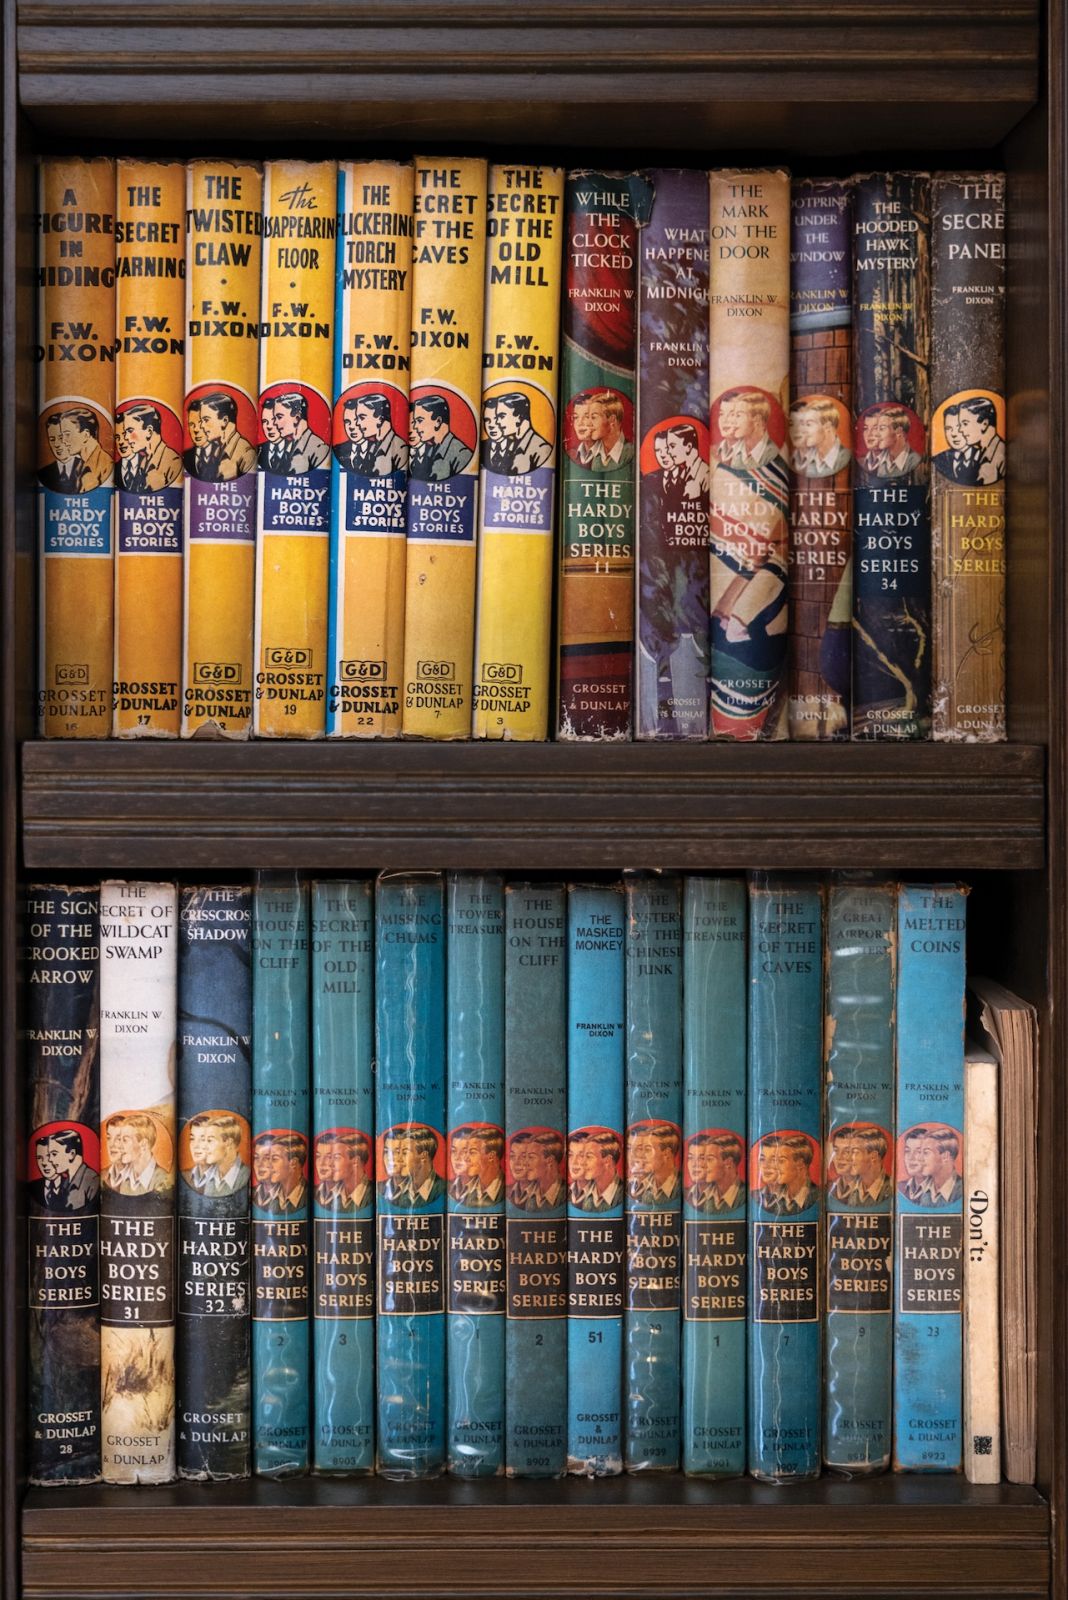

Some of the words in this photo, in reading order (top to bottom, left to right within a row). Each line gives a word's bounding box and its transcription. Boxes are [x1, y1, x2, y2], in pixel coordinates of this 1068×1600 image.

[418, 170, 461, 188] THE
[503, 170, 543, 188] THE
[204, 175, 241, 200] THE
[728, 184, 763, 198] THE
[62, 189, 78, 206] A
[127, 187, 161, 207] THE
[363, 185, 390, 205] THE
[576, 192, 630, 207] WHILE
[722, 205, 769, 218] MARK
[872, 202, 901, 214] THE
[185, 209, 262, 236] TWISTED
[586, 213, 620, 228] THE
[795, 214, 838, 226] UNDER
[516, 218, 553, 239] THE
[711, 225, 737, 239] ON
[742, 225, 777, 239] THE
[855, 220, 919, 234] HOODED
[572, 233, 631, 249] CLOCK
[866, 239, 909, 251] HAWK
[60, 240, 83, 257] IN
[195, 242, 251, 267] CLAW
[346, 242, 396, 263] TORCH
[499, 242, 541, 261] OLD
[719, 246, 769, 259] DOOR
[278, 248, 319, 269] FLOOR
[571, 253, 633, 269] TICKED
[856, 257, 919, 271] MYSTERY
[342, 269, 407, 290] MYSTERY
[490, 265, 549, 286] MILL
[675, 267, 693, 279] AT
[568, 288, 621, 298] FRANKLIN
[272, 303, 315, 317] F.W.
[585, 302, 620, 312] DIXON
[727, 307, 762, 317] DIXON
[421, 308, 456, 325] F.W.
[260, 322, 329, 338] DIXON
[355, 334, 398, 350] F.W.
[495, 335, 539, 350] F.W.
[343, 353, 409, 369] DIXON
[483, 353, 553, 370] DIXON
[581, 483, 621, 498] THE
[870, 490, 908, 502] THE
[139, 496, 164, 506] THE
[412, 495, 467, 508] HARDY
[50, 509, 106, 521] HARDY
[124, 508, 180, 521] HARDY
[279, 503, 320, 516] BOYS
[567, 504, 632, 519] HARDY
[272, 516, 324, 526] STORIES
[353, 516, 405, 528] STORIES
[420, 510, 460, 523] BOYS
[493, 513, 544, 525] STORIES
[858, 513, 920, 526] HARDY
[132, 523, 175, 536] BOYS
[198, 523, 250, 533] STORIES
[412, 523, 464, 534] STORIES
[578, 524, 625, 538] BOYS
[50, 537, 104, 547] STORIES
[125, 537, 178, 548] STORIES
[867, 536, 912, 550] BOYS
[570, 544, 631, 558] SERIES
[594, 561, 610, 574] 11
[861, 560, 919, 573] SERIES
[808, 569, 826, 580] 12
[881, 579, 898, 590] 34
[256, 673, 323, 685] GROSSET
[185, 689, 250, 701] GROSSET
[268, 688, 323, 701] DUNLAP
[330, 686, 398, 698] GROSSET
[407, 683, 464, 695] GROSSET
[573, 684, 626, 694] GROSSET
[121, 698, 177, 711] DUNLAP
[341, 701, 399, 714] DUNLAP
[415, 697, 464, 709] DUNLAP
[480, 700, 531, 712] DUNLAP
[284, 705, 297, 715] 19
[866, 710, 915, 720] GROSSET
[138, 715, 151, 725] 17
[357, 717, 374, 725] 22
[61, 901, 99, 915] SIGN
[151, 906, 173, 918] OF
[513, 918, 563, 929] HOUSE
[904, 918, 966, 931] MELTED
[101, 925, 172, 938] WILDCAT
[187, 929, 248, 941] SHADOW
[384, 932, 438, 944] CHUMS
[576, 928, 623, 938] MASKED
[510, 936, 532, 947] ON
[575, 940, 624, 951] MONKEY
[910, 940, 961, 953] COINS
[106, 946, 163, 959] SWAMP
[519, 955, 559, 966] CLIFF
[762, 961, 812, 973] CAVES
[31, 970, 93, 984] ARROW
[638, 965, 673, 977] JUNK
[115, 1025, 148, 1033] DIXON
[576, 1023, 615, 1031] FRANKLIN
[184, 1036, 239, 1046] FRANKLIN
[42, 1046, 82, 1056] DIXON
[198, 1054, 236, 1063] DIXON
[46, 1223, 82, 1236] THE
[111, 1220, 154, 1236] THE
[195, 1221, 236, 1236] THE
[264, 1223, 300, 1236] THE
[393, 1217, 430, 1230] THE
[969, 1190, 989, 1262] Don't:
[521, 1231, 557, 1244] THE
[577, 1230, 613, 1243] THE
[916, 1226, 952, 1239] THE
[36, 1243, 93, 1257] HARDY
[383, 1238, 441, 1252] HARDY
[317, 1252, 374, 1265] HARDY
[567, 1251, 623, 1264] HARDY
[758, 1246, 816, 1259] HARDY
[45, 1266, 86, 1279] BOYS
[108, 1264, 159, 1280] BOYS
[192, 1262, 240, 1277] BOYS
[392, 1260, 434, 1273] BOYS
[519, 1273, 561, 1286] BOYS
[767, 1268, 808, 1280] BOYS
[385, 1281, 439, 1294] SERIES
[698, 1275, 740, 1288] BOYS
[103, 1285, 166, 1301] SERIES
[185, 1281, 245, 1297] SERIES
[760, 1288, 814, 1301] SERIES
[907, 1289, 961, 1302] SERIES
[569, 1293, 622, 1306] SERIES
[206, 1300, 225, 1313] 32
[124, 1307, 140, 1320] 31
[588, 1331, 603, 1344] 51
[859, 1327, 865, 1337] 9
[927, 1327, 940, 1337] 23
[339, 1334, 347, 1345] 3
[535, 1335, 544, 1346] 2
[713, 1336, 720, 1347] 1
[783, 1336, 790, 1346] 7
[38, 1410, 93, 1424] GROSSET
[183, 1412, 244, 1424] GROSSET
[576, 1413, 619, 1422] GROSSET
[46, 1425, 96, 1439] DUNLAP
[191, 1431, 248, 1442] DUNLAP
[106, 1435, 161, 1446] GROSSET
[59, 1445, 73, 1454] 28
[113, 1454, 165, 1465] DUNLAP
[332, 1456, 356, 1465] 8903
[526, 1457, 550, 1466] 8902
